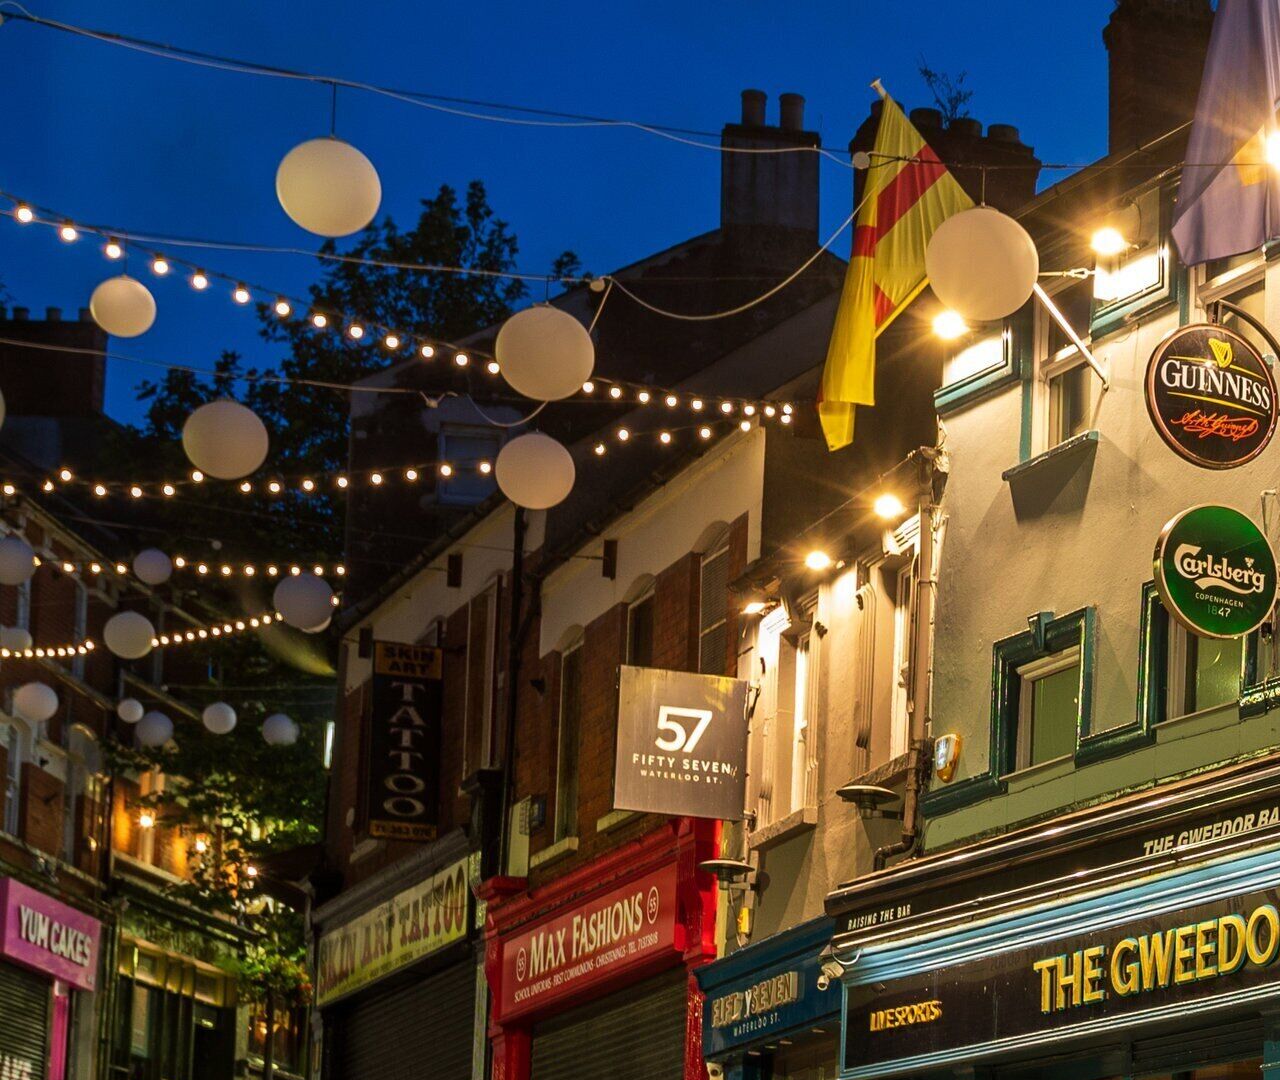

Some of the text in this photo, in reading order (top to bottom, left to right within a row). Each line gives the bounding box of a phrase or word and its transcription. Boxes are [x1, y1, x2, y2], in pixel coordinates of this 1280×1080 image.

[1160, 359, 1271, 414] GUINNESS
[1174, 542, 1265, 595] Carlsberg
[1195, 592, 1244, 609] COPENHAGEN
[1206, 604, 1231, 618] 1847
[384, 646, 435, 663] SKIN
[388, 662, 429, 675] ART
[655, 705, 713, 753] 57
[383, 681, 426, 817] TATTOO
[632, 753, 731, 775] FIFTY SEVEN
[640, 769, 722, 785] WATERLOO ST.
[1143, 836, 1175, 856] THE
[398, 865, 466, 946] TATTOO
[847, 903, 912, 931] RAISING THE BAR
[19, 904, 92, 967] YUM CAKES
[529, 892, 643, 978] MAX FASHIONS
[751, 971, 798, 1013] SEVEN
[1033, 945, 1107, 1015] THE
[733, 1017, 767, 1037] WATERLOO
[869, 1009, 894, 1032] LIVE
